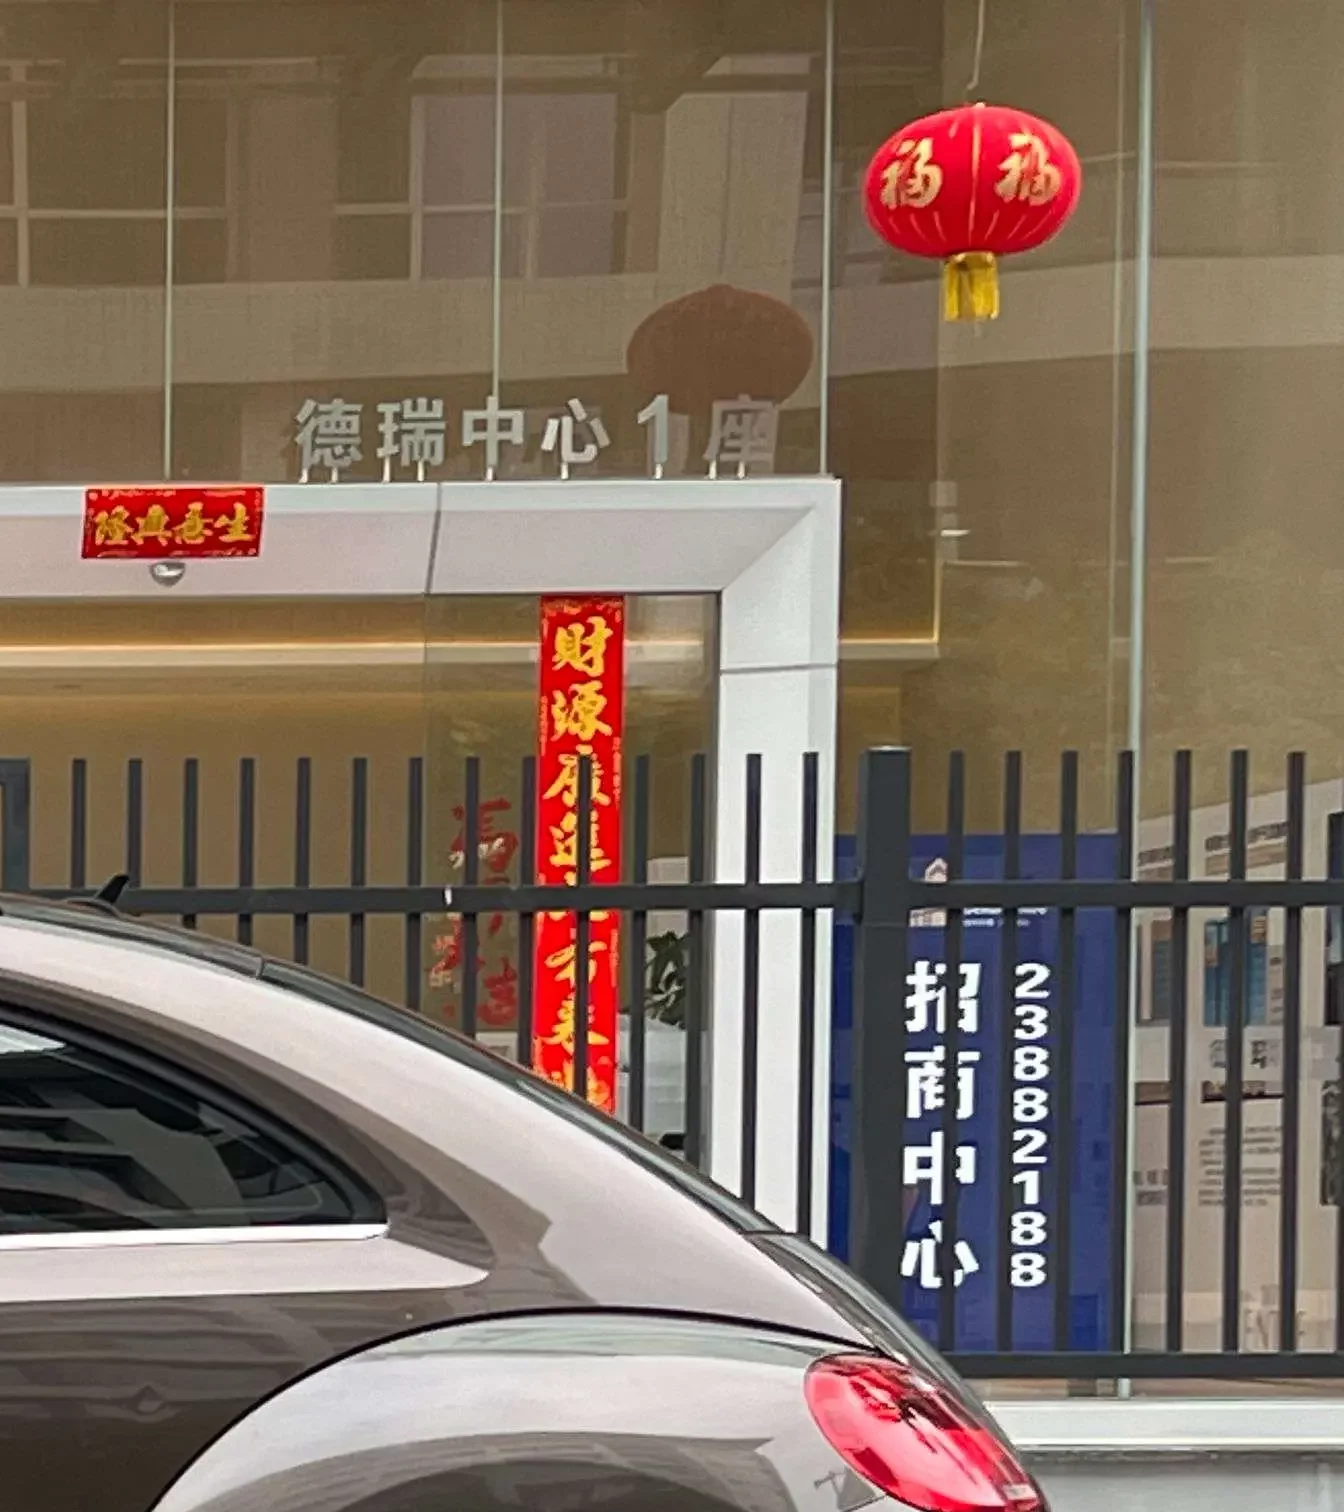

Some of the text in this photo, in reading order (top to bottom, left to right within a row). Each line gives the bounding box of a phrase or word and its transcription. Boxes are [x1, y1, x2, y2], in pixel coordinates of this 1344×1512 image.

[880, 132, 1062, 209] 福 福
[295, 394, 777, 467] 德瑞中心1座
[1010, 963, 1051, 1288] 23882188
